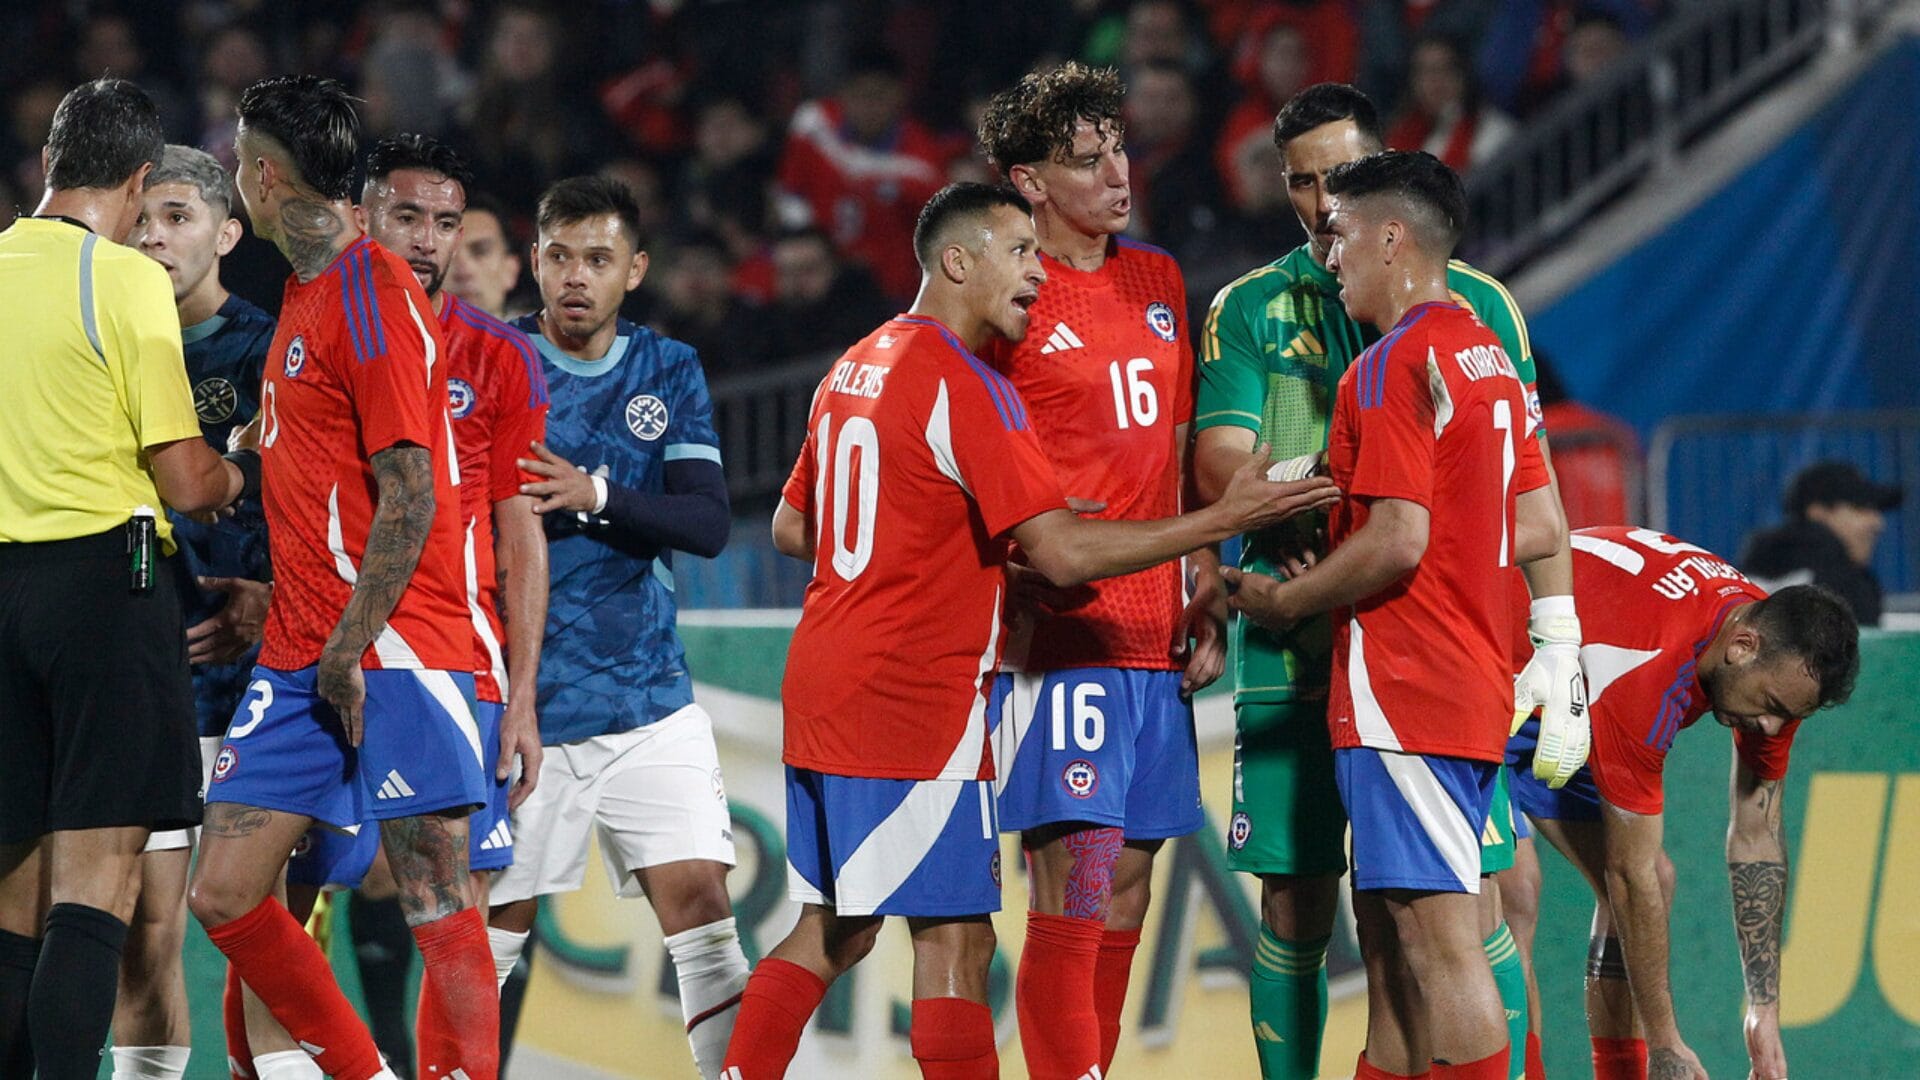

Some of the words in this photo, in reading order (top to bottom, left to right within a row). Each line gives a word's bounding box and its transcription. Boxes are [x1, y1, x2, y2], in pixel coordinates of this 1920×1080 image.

[829, 361, 890, 399] ALEXIS
[1109, 357, 1158, 429] 16
[814, 411, 880, 582] 10
[1051, 682, 1106, 752] 16
